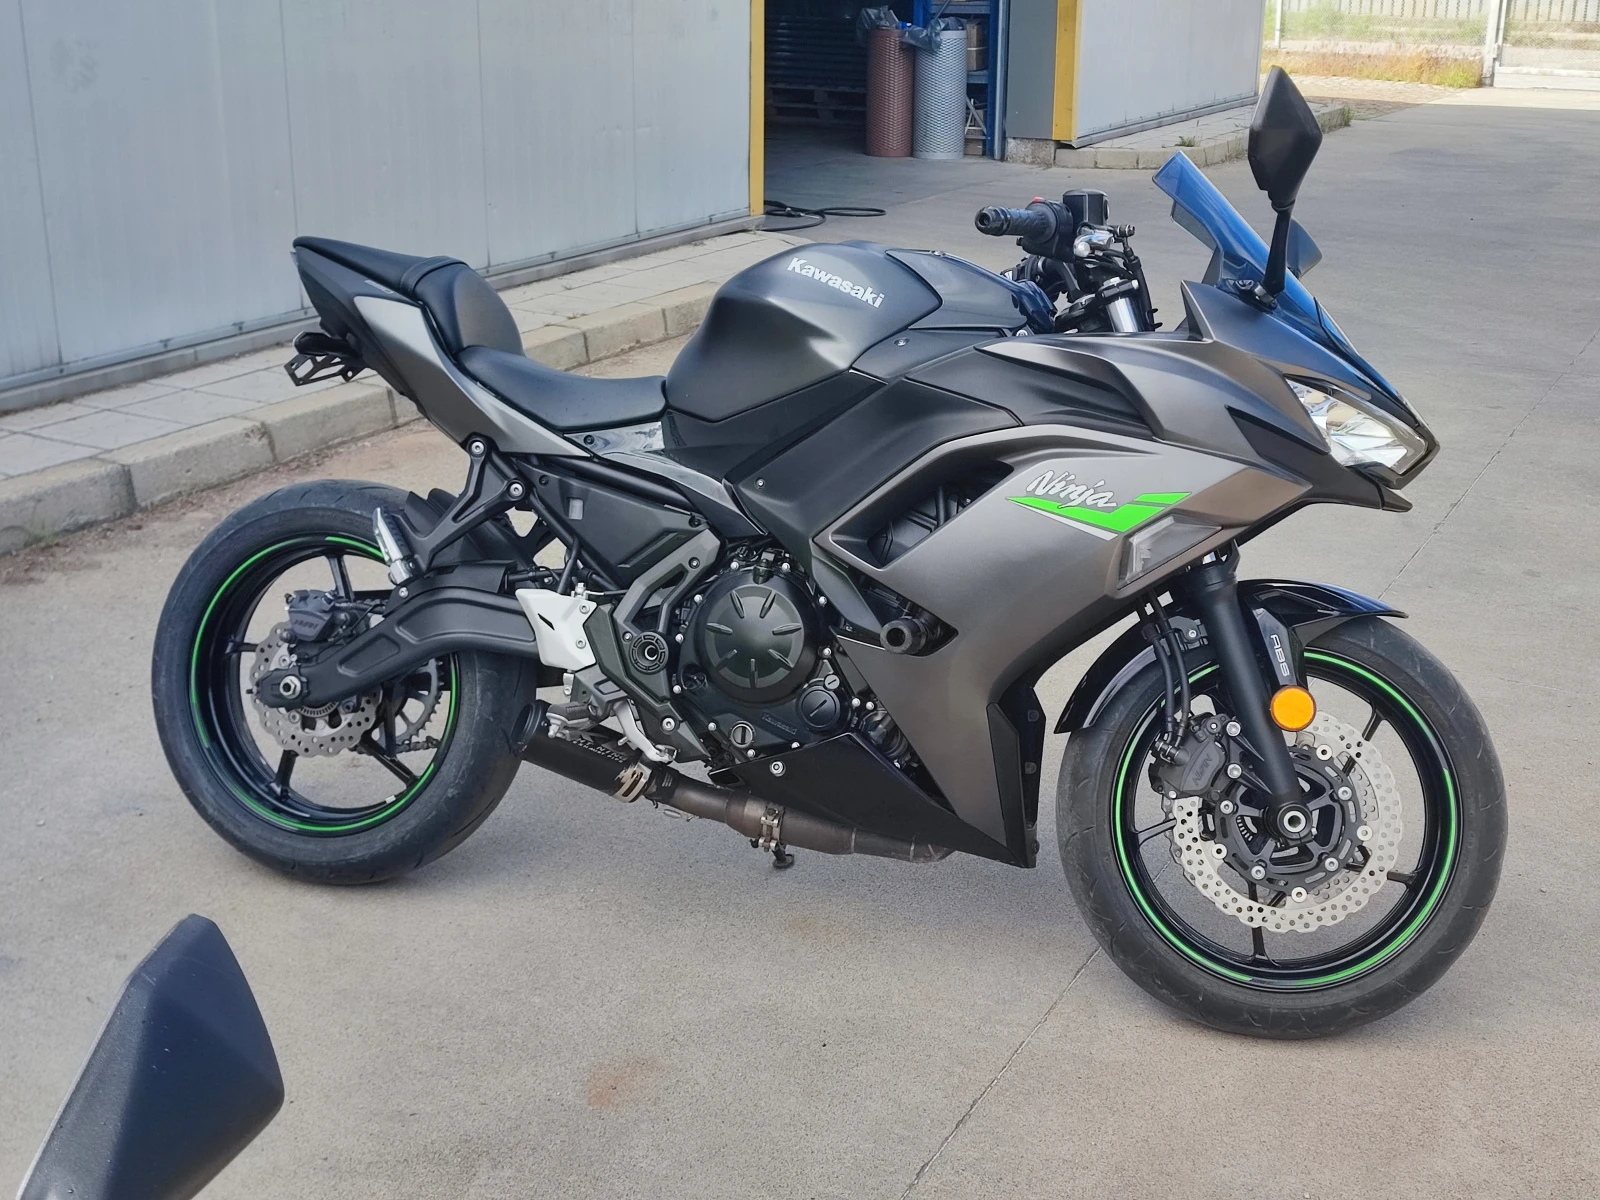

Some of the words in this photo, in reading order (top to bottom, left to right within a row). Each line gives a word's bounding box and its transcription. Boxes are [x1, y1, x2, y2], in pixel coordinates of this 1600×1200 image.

[787, 257, 885, 308] Kawasaki
[1026, 469, 1117, 509] Ninja
[1270, 634, 1290, 677] ABS
